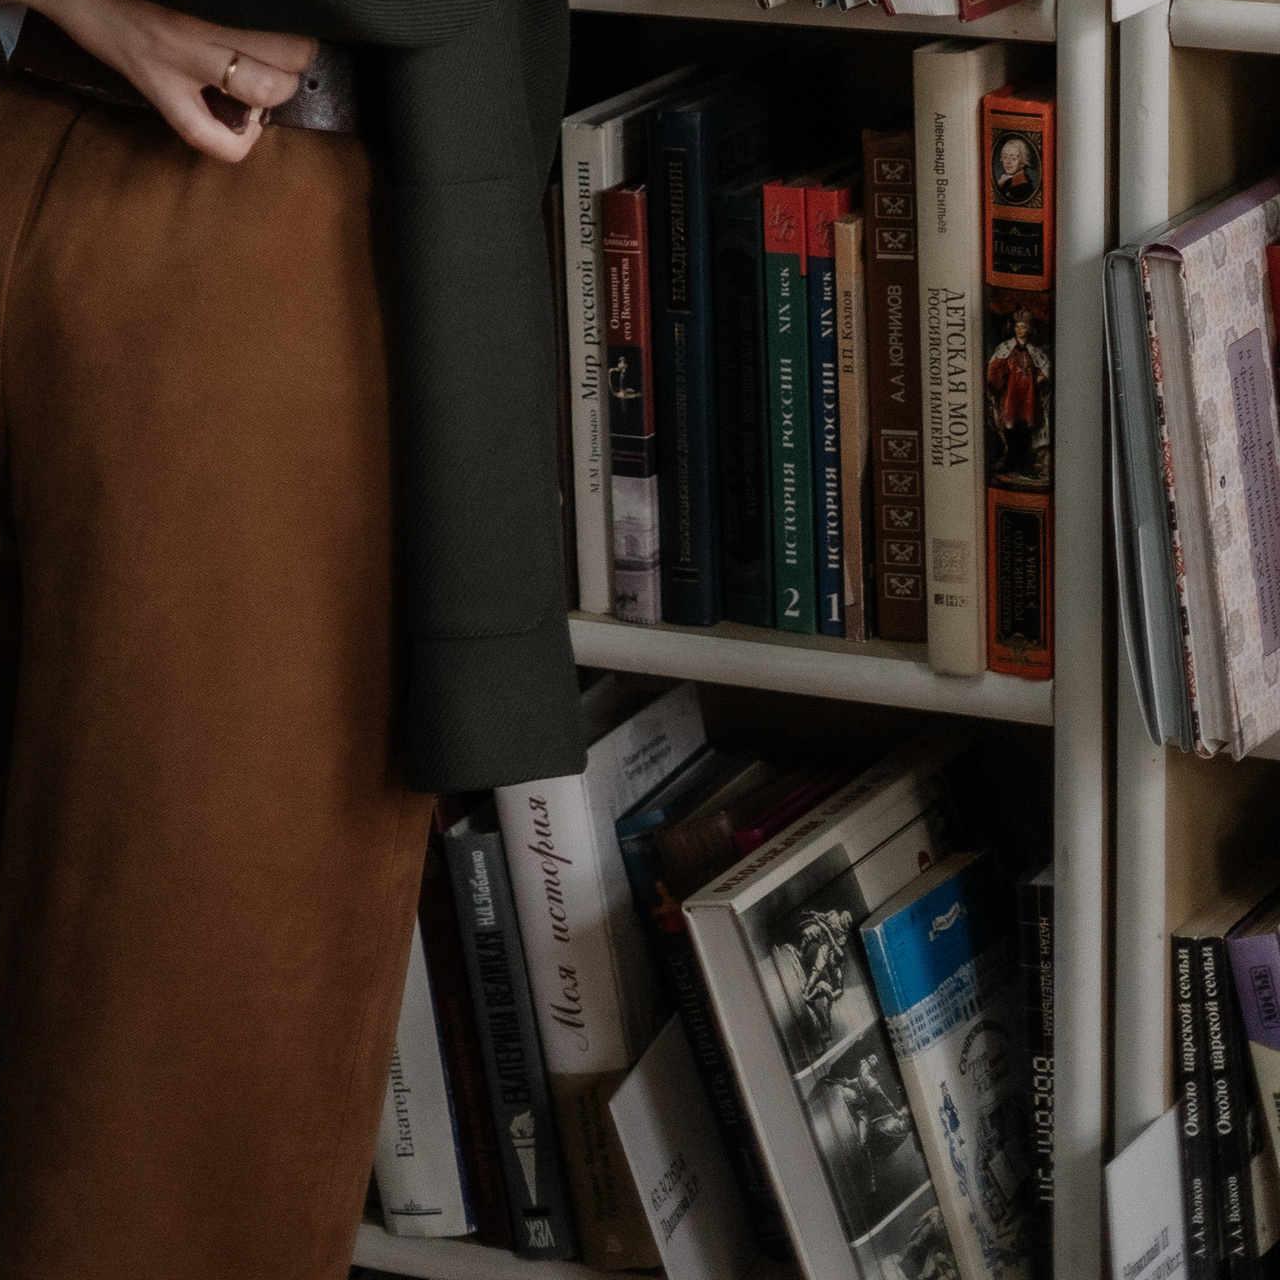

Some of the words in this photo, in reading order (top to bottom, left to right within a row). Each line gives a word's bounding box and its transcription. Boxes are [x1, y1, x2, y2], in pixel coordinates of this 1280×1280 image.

[931, 112, 948, 175] Александр
[575, 160, 597, 250] деревни
[935, 178, 950, 233] Васильев
[575, 259, 601, 345] русской
[778, 267, 789, 295] век
[820, 271, 832, 300] век
[778, 304, 790, 333] XIX
[820, 308, 833, 337] XIX
[886, 284, 903, 366] КОРНИЛОВ
[927, 287, 944, 386] РОССИЙСКОЙ
[941, 288, 968, 396] ДЕТСКАЯ
[579, 355, 601, 399] Мир
[780, 358, 794, 447] РОССИИ
[822, 362, 837, 451] РОССИИ
[1231, 376, 1245, 427] конца
[930, 390, 945, 466] ИМПЕРИИ
[944, 401, 970, 467] МОДА
[1238, 433, 1250, 466] XIX
[782, 462, 796, 563] ИСТОРИЯ
[824, 467, 839, 569] ИСТОРИЯ
[1245, 486, 1260, 547] начала
[1253, 553, 1264, 580] XX
[783, 587, 801, 618] 2
[826, 592, 841, 623] 1
[1257, 586, 1270, 625] века
[519, 791, 584, 947] история
[1038, 917, 1051, 954] НАТАН
[1040, 960, 1055, 1036] ЭЙДЕЛЬМАН
[1177, 947, 1191, 999] семьи
[1200, 946, 1216, 997] семьи
[541, 962, 589, 1056] Моя
[1178, 1003, 1197, 1071] царской
[1203, 1000, 1226, 1070] царской
[1181, 1081, 1200, 1136] Около
[1211, 1079, 1231, 1134] Около
